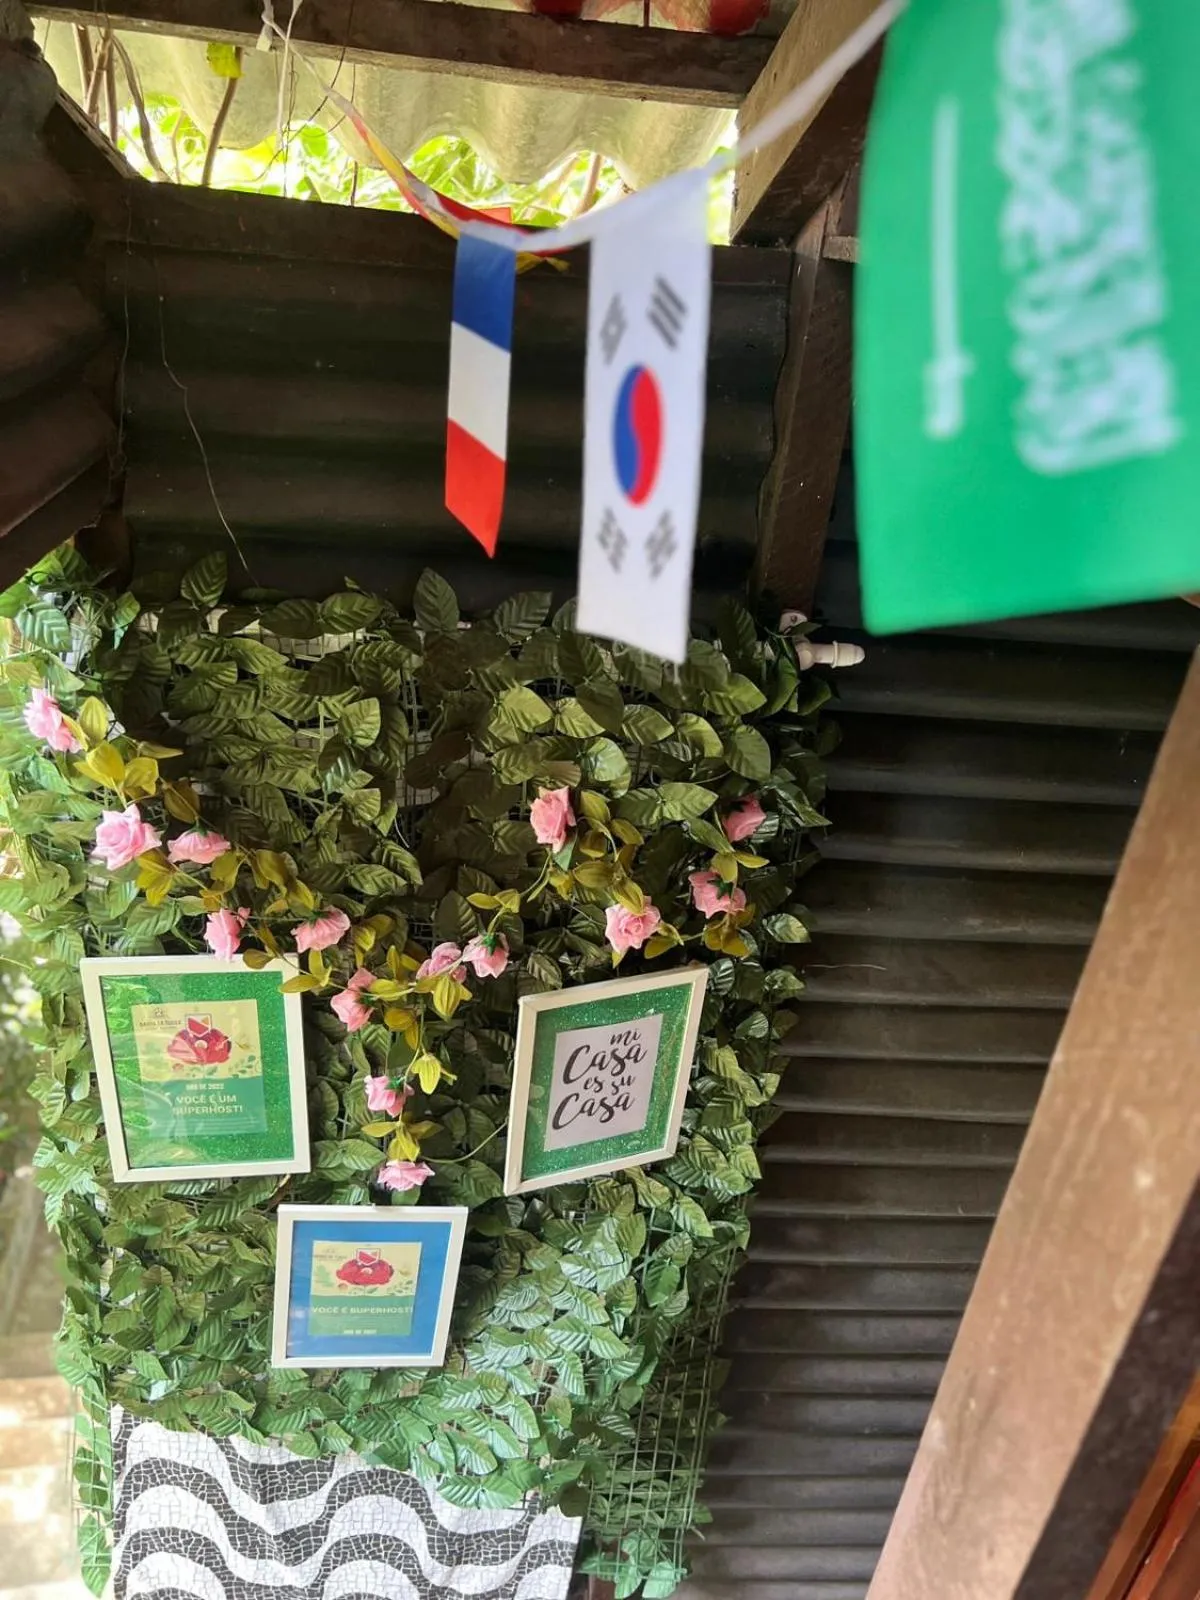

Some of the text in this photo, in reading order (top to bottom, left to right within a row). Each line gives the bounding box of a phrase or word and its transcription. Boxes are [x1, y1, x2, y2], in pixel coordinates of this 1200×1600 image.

[610, 1028, 641, 1046] mi
[562, 1043, 648, 1084] Casa
[583, 1075, 636, 1096] es su
[552, 1092, 635, 1130] Casa
